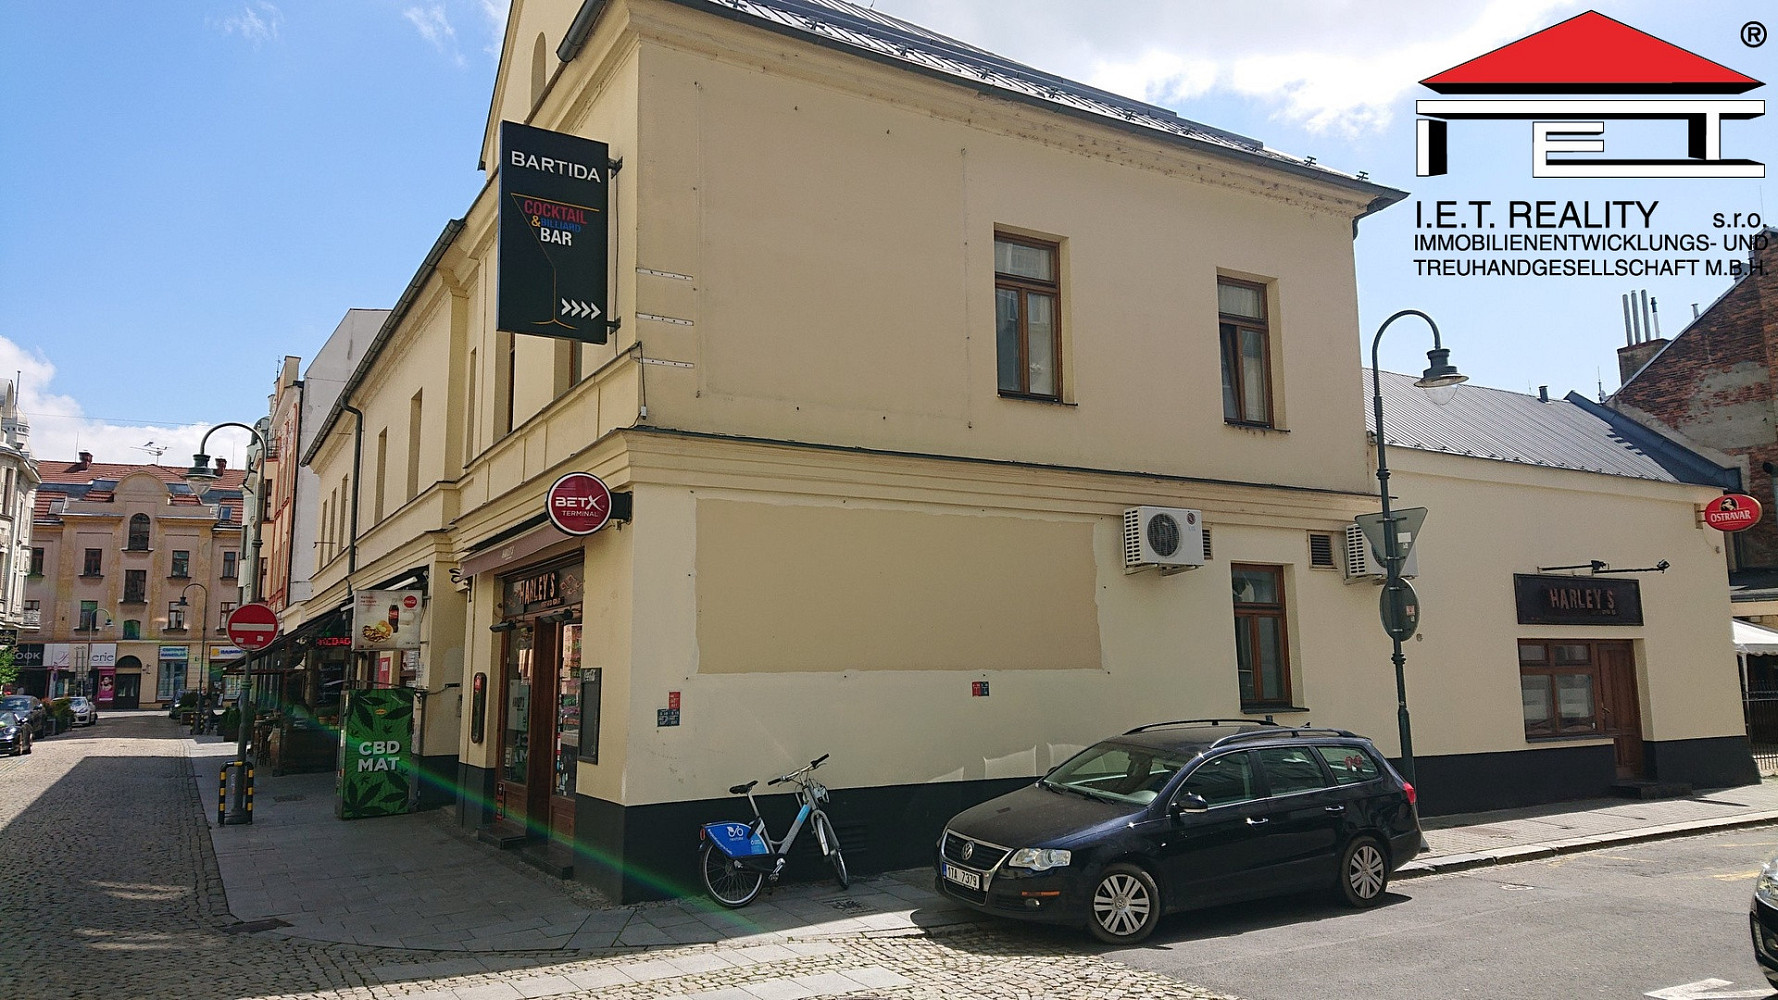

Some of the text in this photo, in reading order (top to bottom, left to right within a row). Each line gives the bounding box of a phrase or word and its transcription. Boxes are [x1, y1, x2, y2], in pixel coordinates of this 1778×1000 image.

[511, 150, 601, 183] BARTIDA
[523, 199, 587, 225] COCKTAIL
[541, 217, 582, 233] BILLIARD
[540, 227, 572, 247] BAR
[561, 510, 599, 518] TERMINAL
[1710, 510, 1752, 523] OSTRAVAR
[519, 572, 556, 605] HARLEYS
[1549, 586, 1615, 609] HARLEYS
[14, 652, 41, 660] OOK
[90, 652, 114, 661] erie
[358, 740, 401, 756] CBD
[357, 756, 401, 773] MAT
[961, 871, 977, 887] 7379
